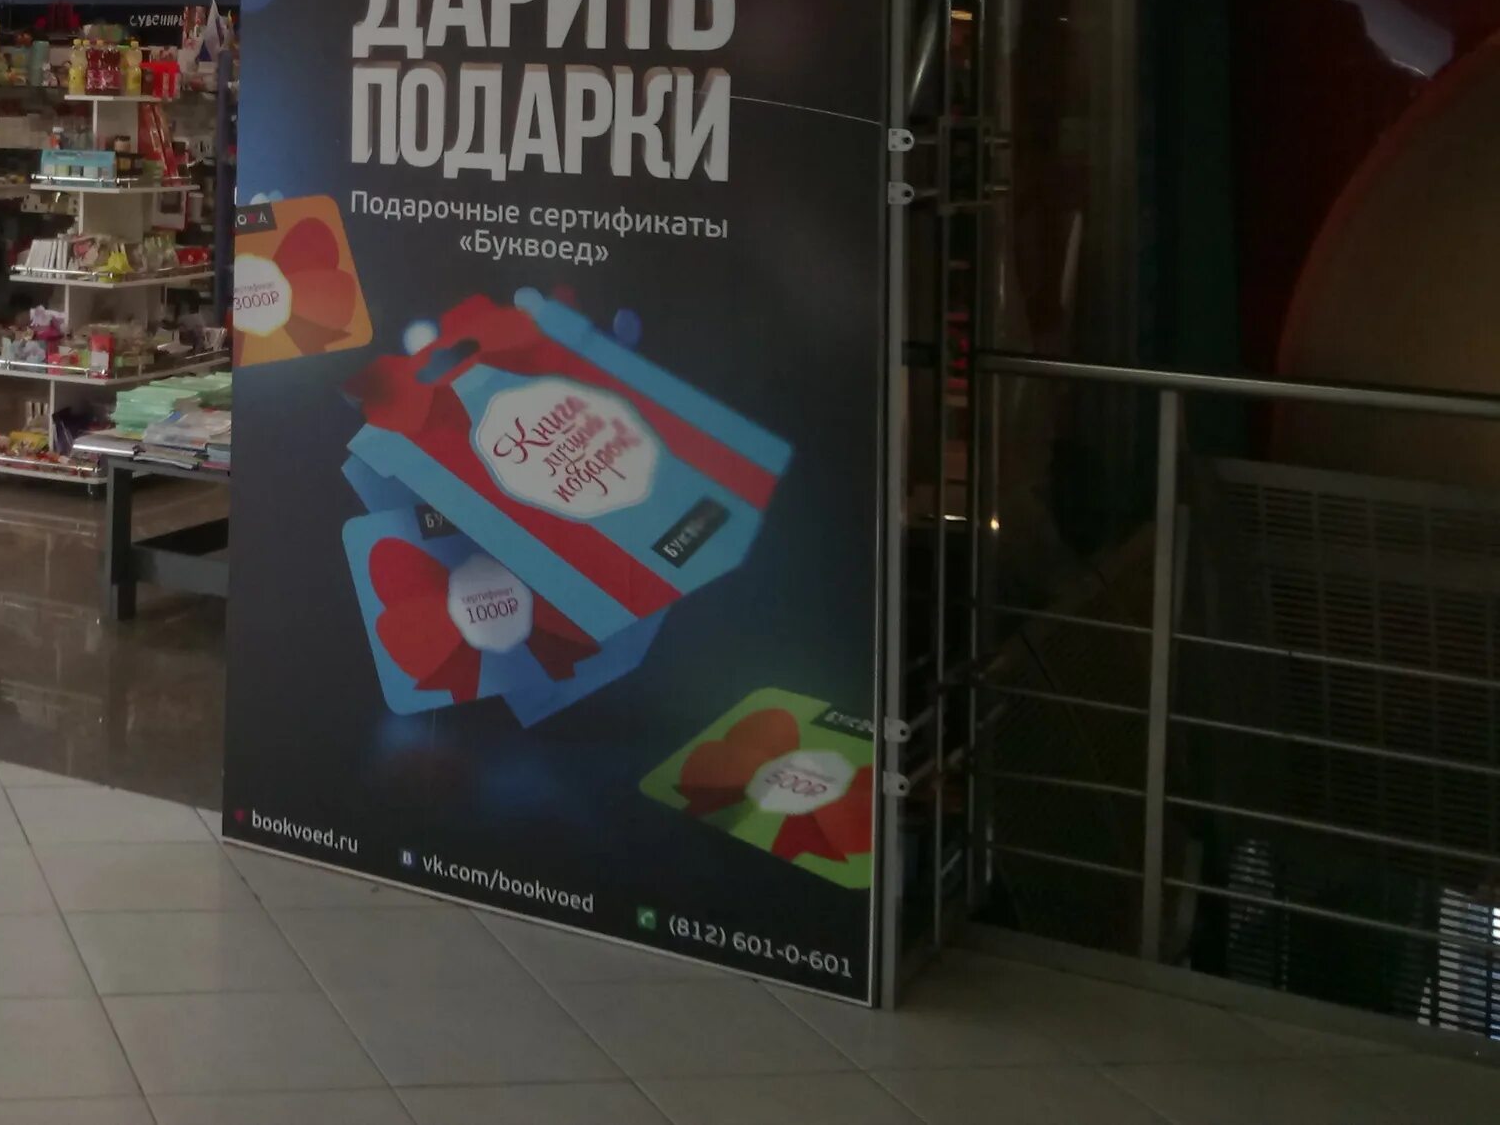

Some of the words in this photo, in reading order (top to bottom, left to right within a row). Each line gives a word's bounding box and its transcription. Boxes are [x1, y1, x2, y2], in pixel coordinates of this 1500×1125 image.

[350, 63, 732, 183] ПОДАРКИ
[350, 190, 519, 223] Подарочные
[529, 206, 729, 238] сертификаты
[458, 229, 609, 266] «Буквоед»
[252, 809, 358, 854] bookvoed.ru
[422, 853, 594, 913] vk.com/bookvoed
[668, 914, 726, 947] (812)
[732, 931, 853, 978] 601-0-601
